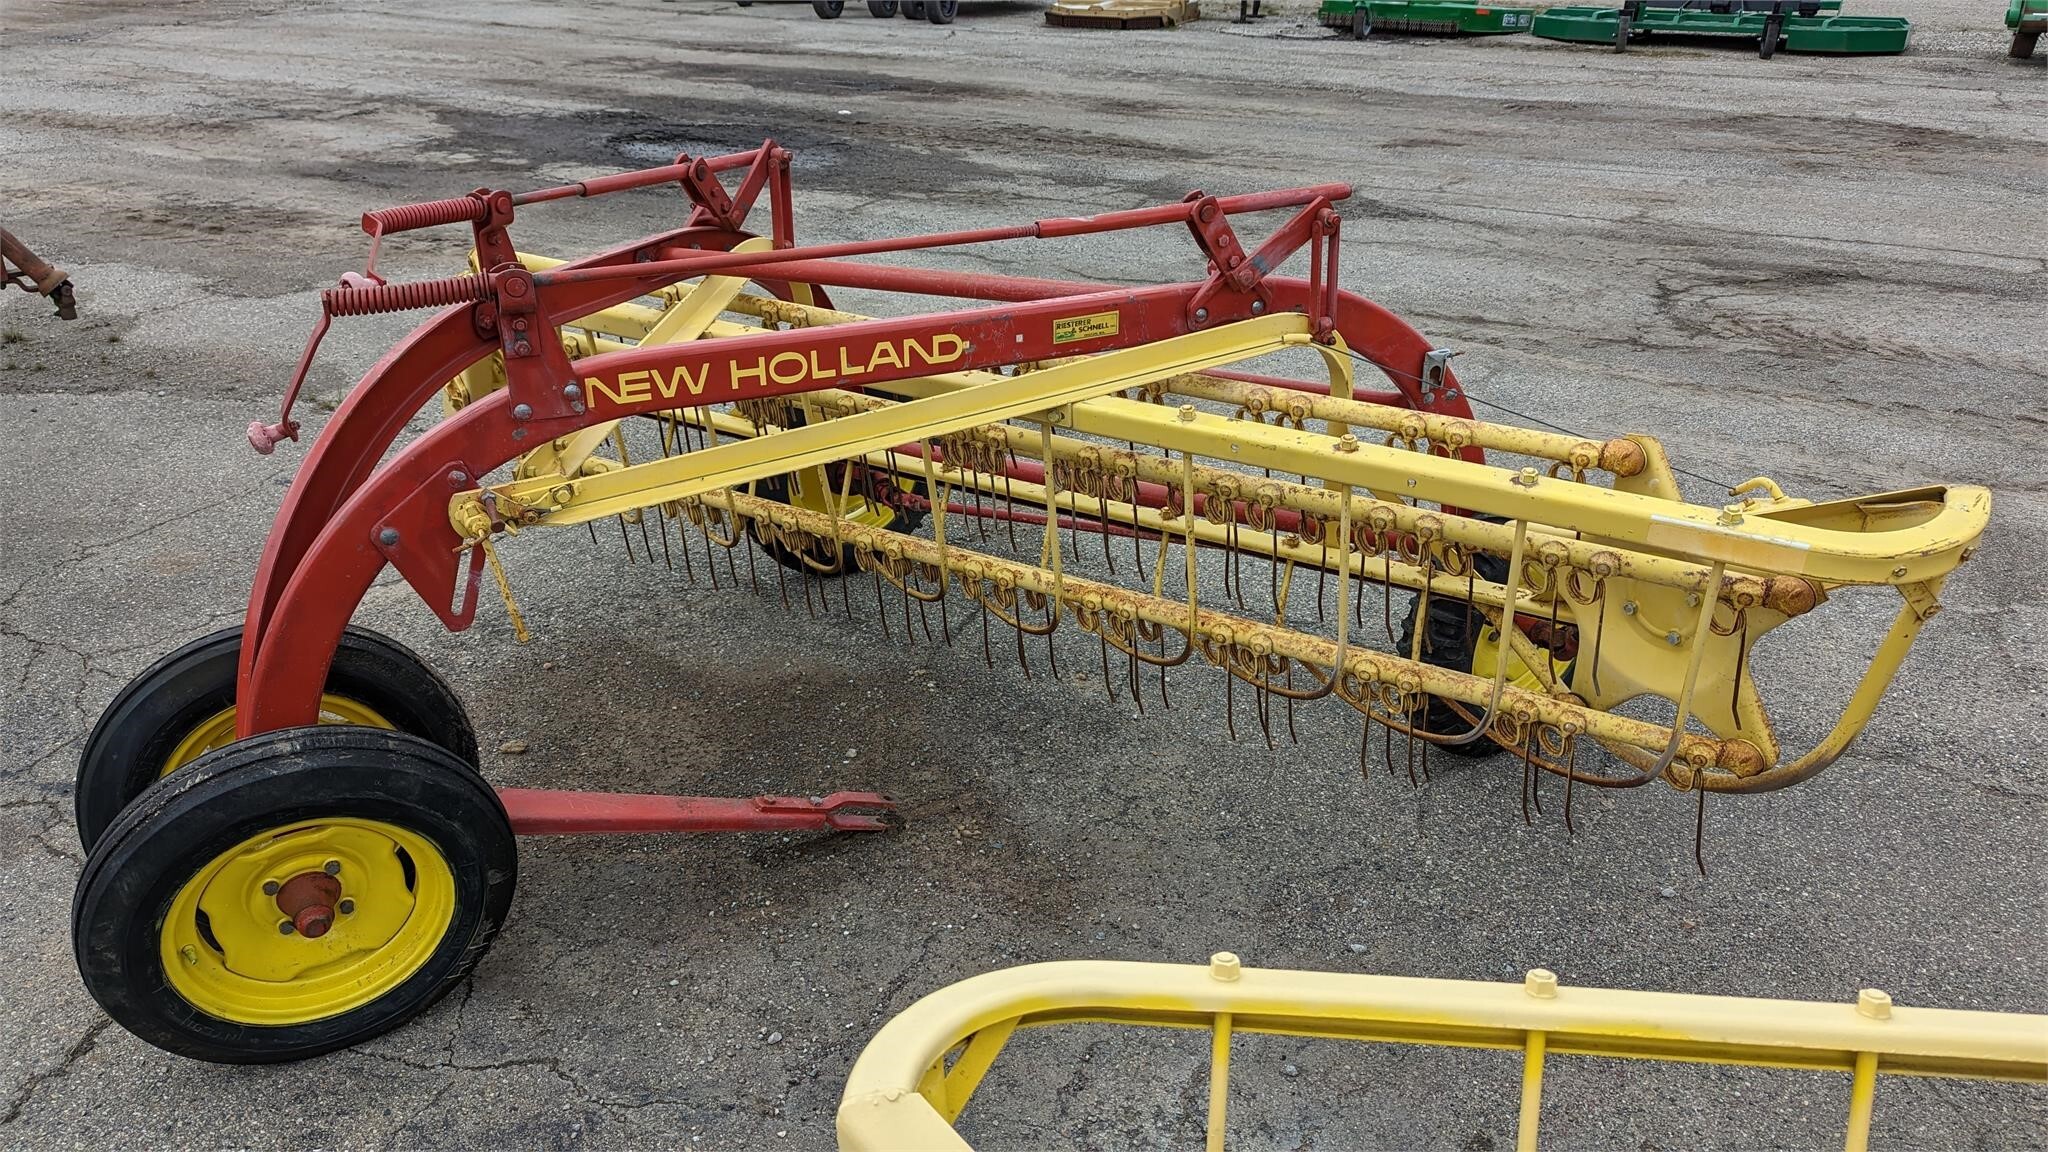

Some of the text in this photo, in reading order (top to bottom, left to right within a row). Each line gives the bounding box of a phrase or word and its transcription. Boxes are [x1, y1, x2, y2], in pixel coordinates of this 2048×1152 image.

[1056, 318, 1092, 330] RIESTERER
[1078, 322, 1110, 333] SCHNELL
[585, 333, 964, 408] NEW HOLLAND
